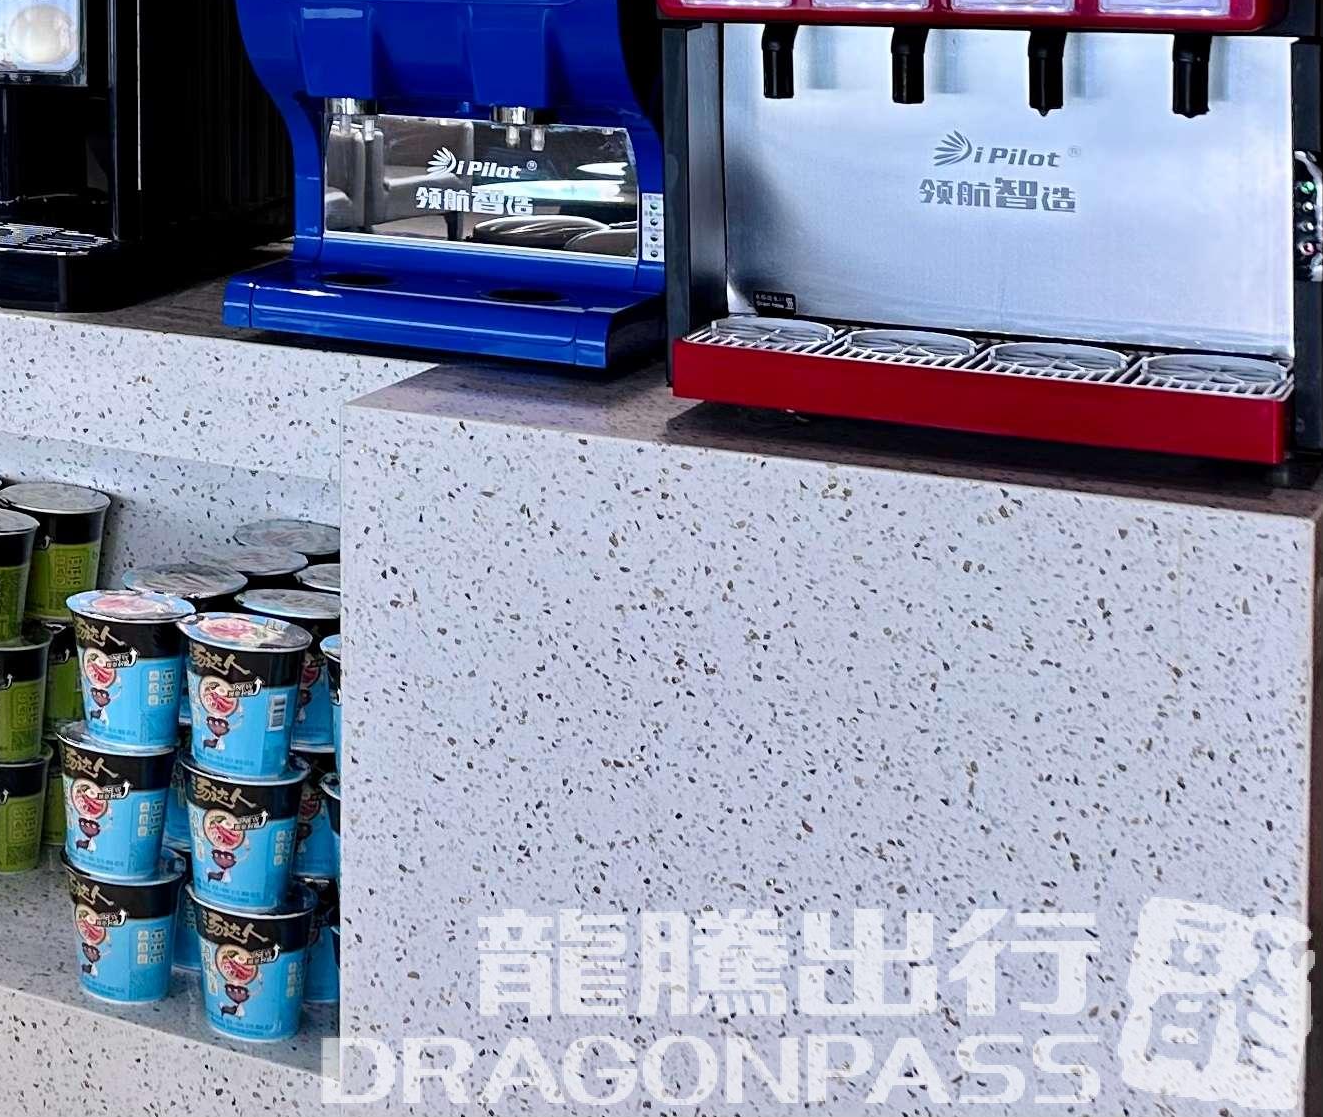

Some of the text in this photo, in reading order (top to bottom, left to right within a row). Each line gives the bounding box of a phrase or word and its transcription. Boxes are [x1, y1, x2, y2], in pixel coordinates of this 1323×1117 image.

[415, 186, 534, 216] 领航智造
[919, 176, 1077, 213] 领航智造
[189, 641, 252, 676] 汤达人
[192, 775, 257, 810] 汤达人
[202, 910, 270, 944] 汤达人
